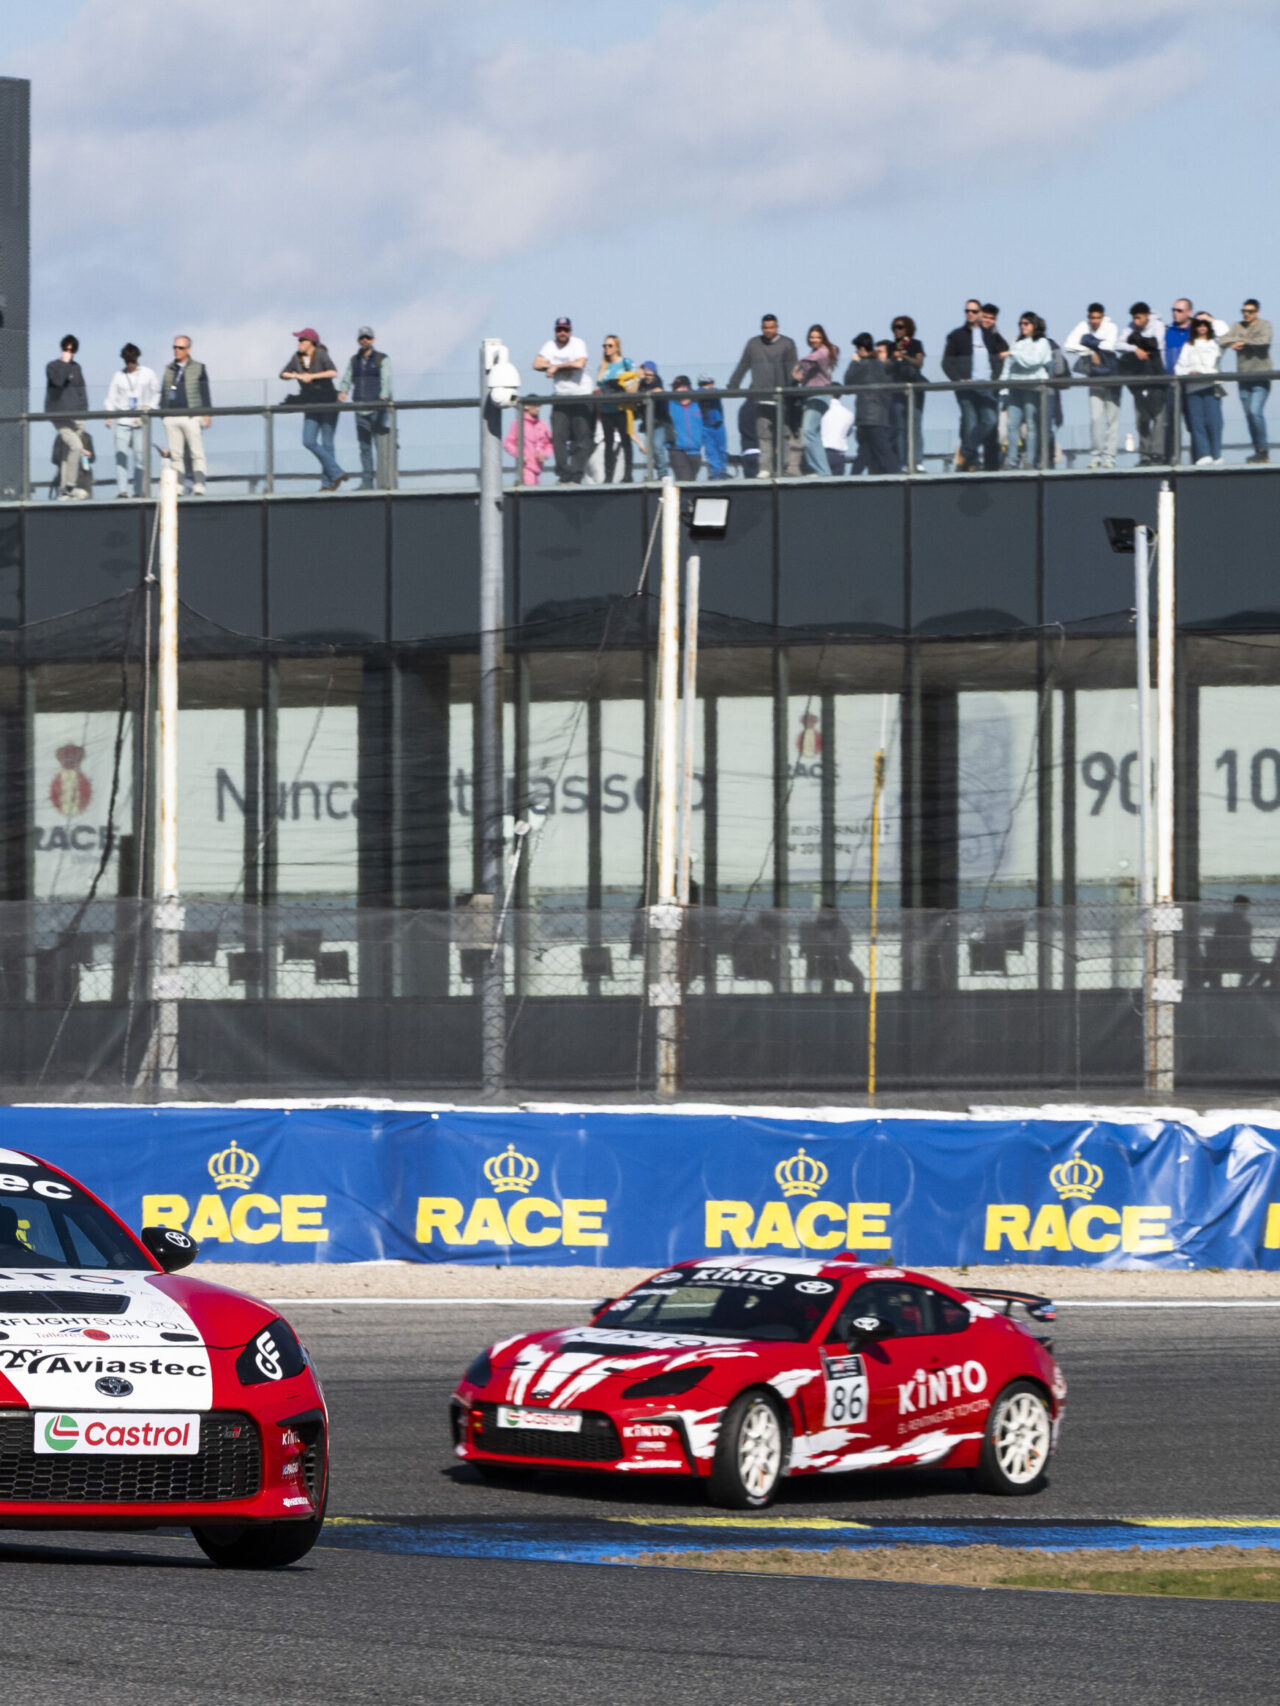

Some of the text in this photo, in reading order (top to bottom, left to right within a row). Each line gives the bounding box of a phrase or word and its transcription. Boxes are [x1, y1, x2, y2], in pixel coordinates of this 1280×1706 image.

[142, 1193, 329, 1243] RACE
[416, 1197, 608, 1247] RACE
[704, 1200, 892, 1250] RACE
[984, 1204, 1173, 1253] RACE
[46, 1356, 207, 1377] Aviastec
[831, 1384, 863, 1421] 86
[84, 1422, 190, 1446] Castrol
